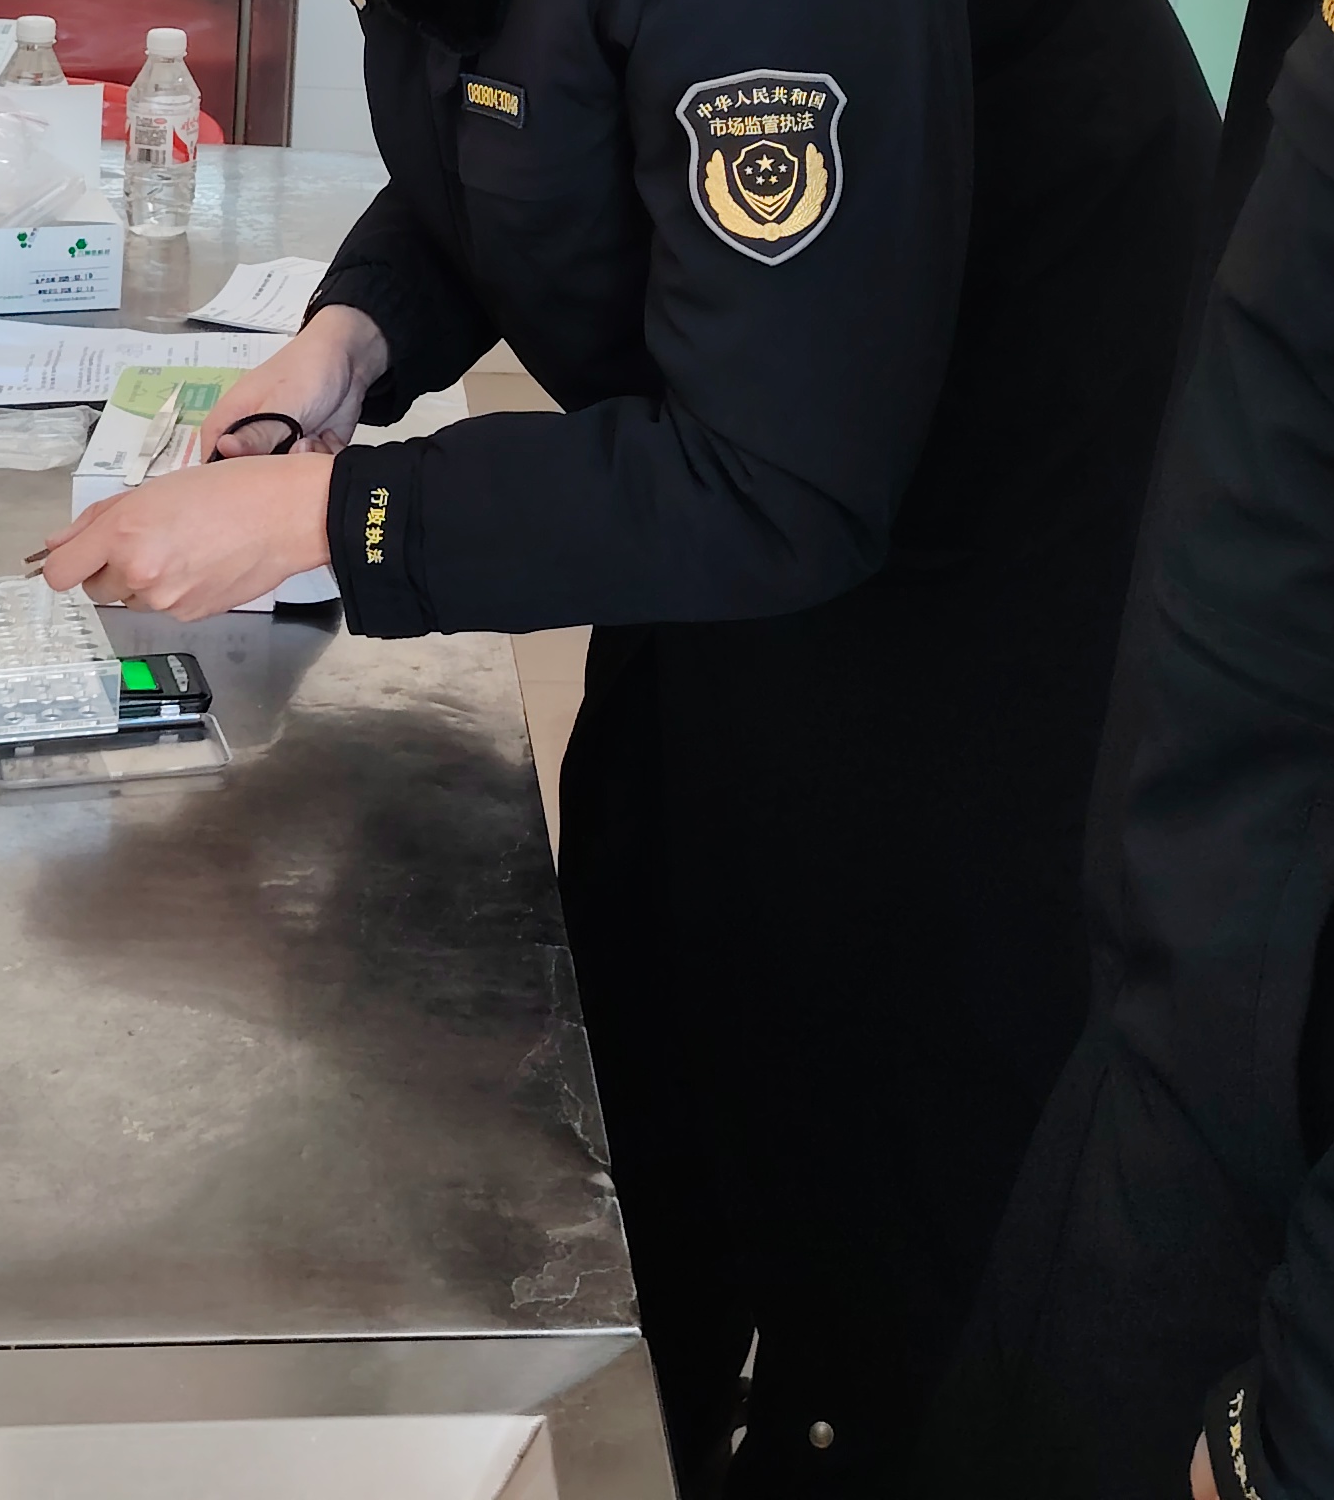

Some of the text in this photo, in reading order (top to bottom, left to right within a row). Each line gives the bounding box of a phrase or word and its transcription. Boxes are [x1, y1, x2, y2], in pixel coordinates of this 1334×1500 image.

[696, 86, 828, 120] 中华人民共和国
[708, 112, 815, 138] 市场监管执法
[365, 488, 389, 563] 行政执法
